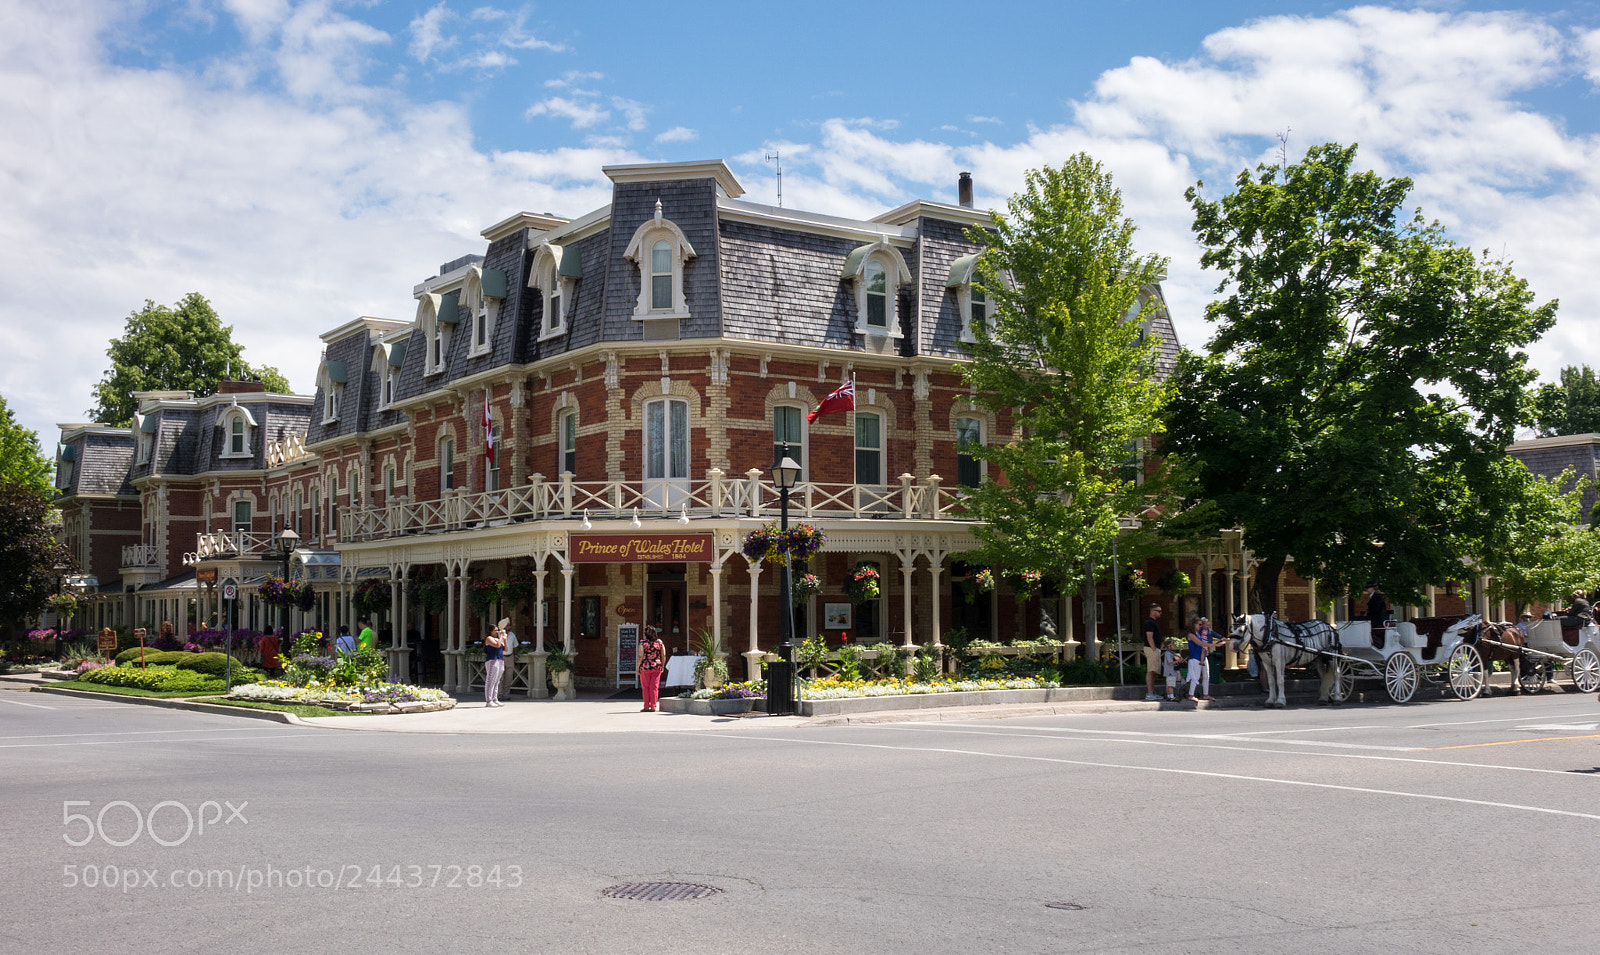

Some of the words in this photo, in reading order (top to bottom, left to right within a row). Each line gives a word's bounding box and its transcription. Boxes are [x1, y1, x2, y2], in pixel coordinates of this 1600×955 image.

[578, 540, 618, 554] Prince
[619, 539, 634, 557] of
[633, 539, 672, 555] Wales
[671, 539, 705, 553] Hotel
